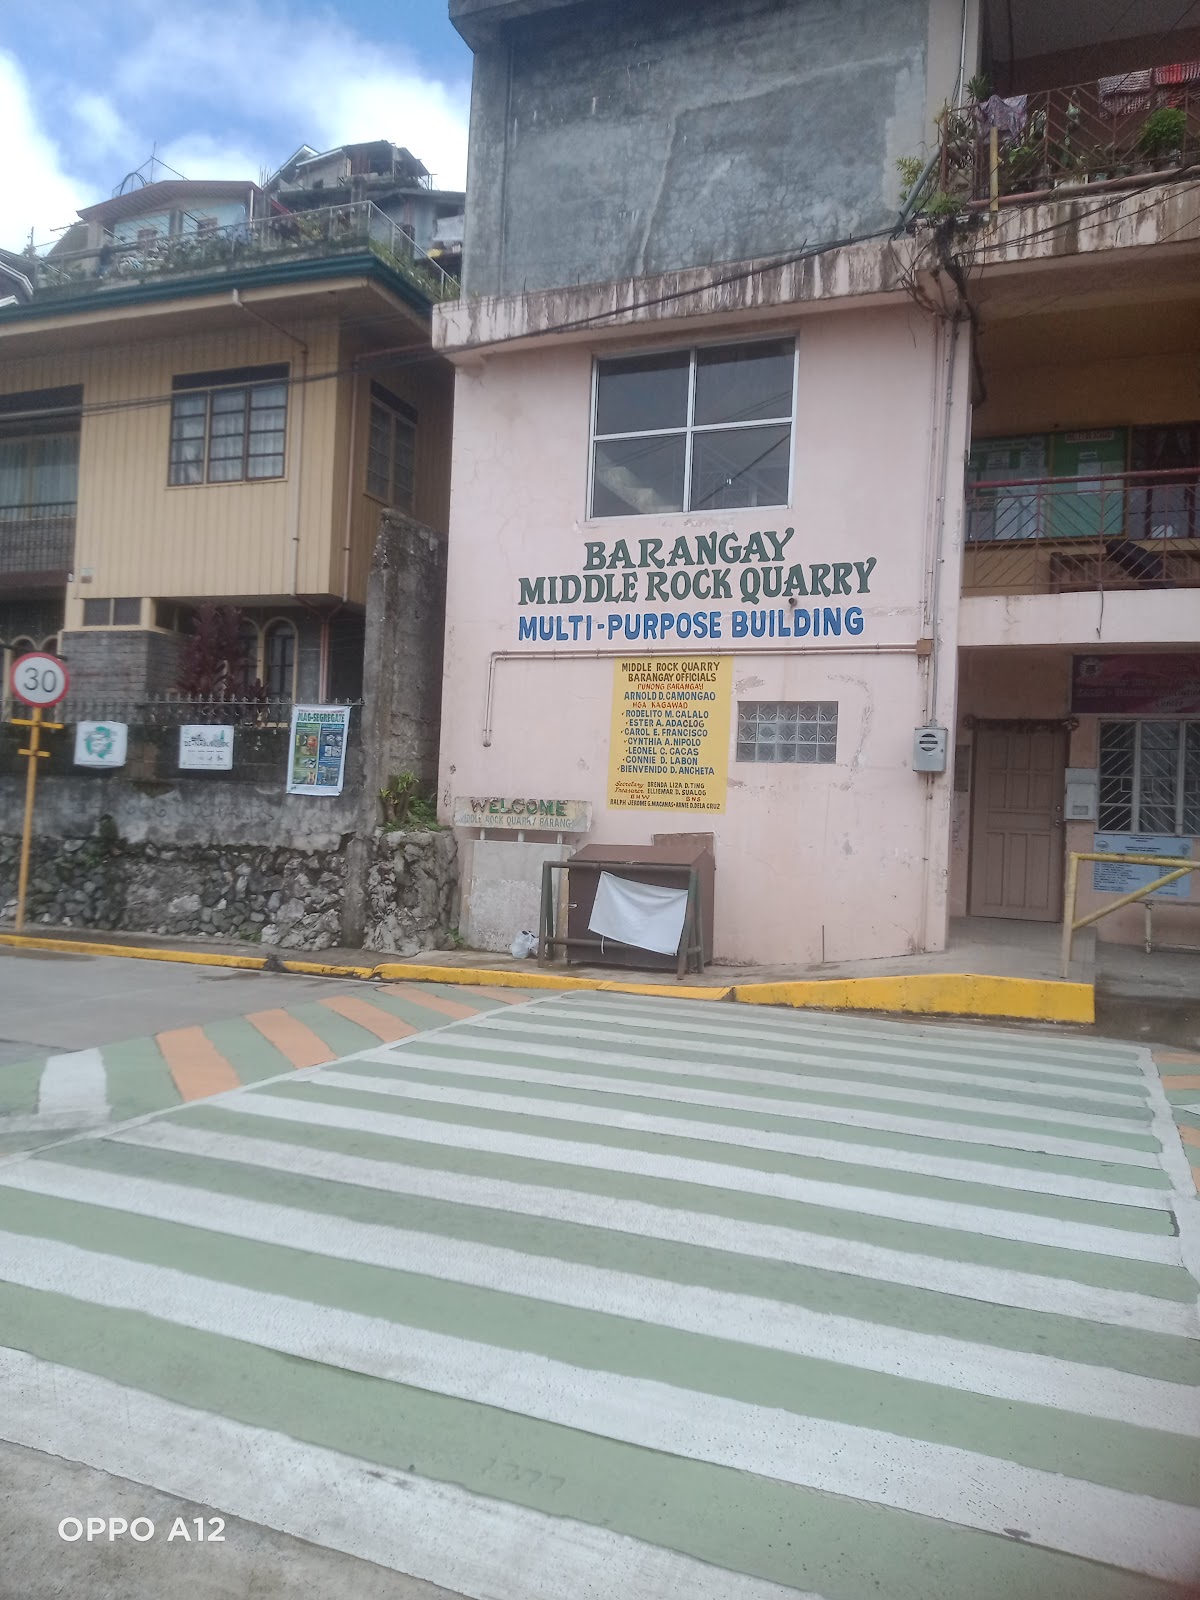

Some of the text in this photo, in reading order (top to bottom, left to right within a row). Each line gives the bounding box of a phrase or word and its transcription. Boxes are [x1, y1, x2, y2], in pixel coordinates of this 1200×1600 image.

[583, 527, 795, 571] BARANGAY
[518, 557, 878, 606] MIDDLE ROCK QUARRY
[518, 606, 865, 641] MULTI-PURPOSE BUILDING
[622, 662, 720, 672] MIDDLE ROCK QUARRY
[24, 668, 56, 692] 30
[628, 672, 717, 682] BARANGAY OFFICIALS
[624, 691, 657, 700] ARNOLD
[626, 710, 662, 718] RODELITO
[676, 710, 709, 718] CALALO
[629, 718, 654, 727] ESTER
[665, 720, 705, 728] ADACLOG
[624, 728, 650, 736] CAROL
[662, 728, 708, 737] FRANCISCO
[628, 737, 662, 746] CYNTHIA
[628, 746, 658, 755] LEONEL
[670, 748, 700, 756] CACAS
[626, 756, 656, 764] CONNIE
[670, 756, 698, 765] LABON
[620, 765, 668, 774] BIENVENIDO
[679, 766, 714, 775] ANCHETA
[470, 797, 568, 816] WELCOME
